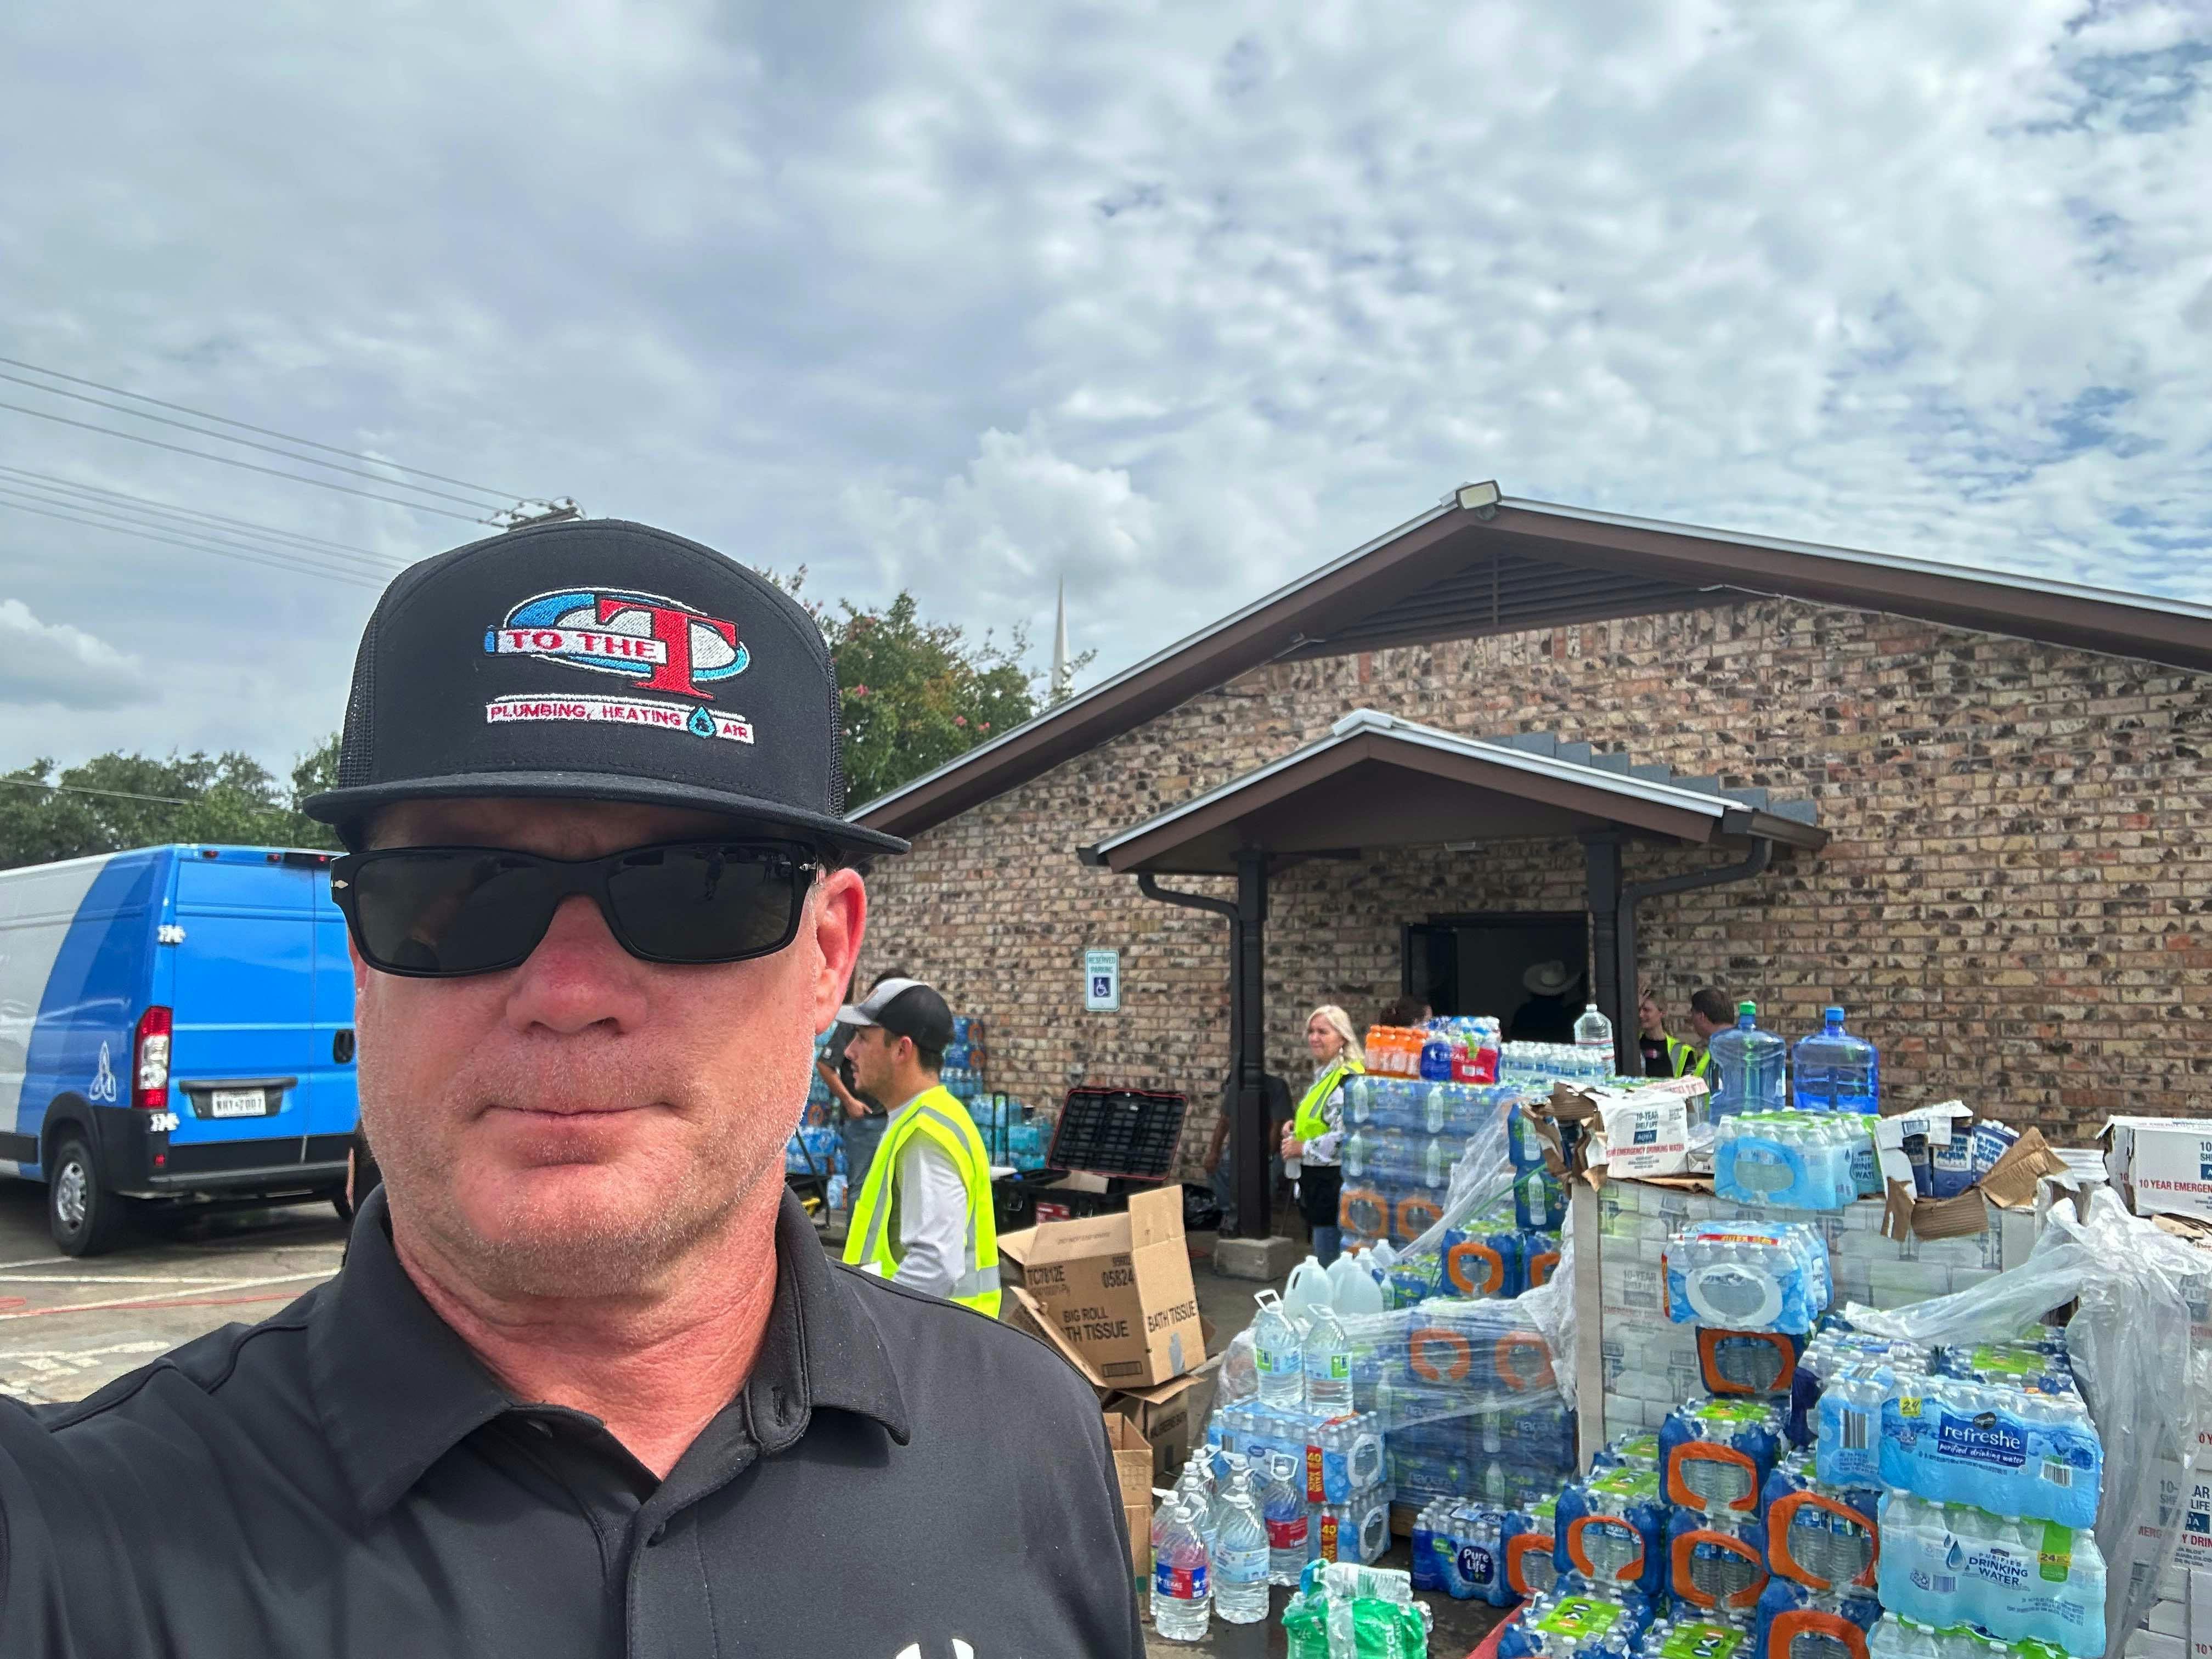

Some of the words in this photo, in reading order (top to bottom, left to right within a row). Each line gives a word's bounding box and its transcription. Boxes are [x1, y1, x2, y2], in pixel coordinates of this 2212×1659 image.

[506, 630, 563, 650] TO
[576, 633, 657, 658] THE
[490, 703, 592, 720] PLUMBING,
[603, 706, 682, 727] HEATING
[723, 723, 748, 739] AIR
[1637, 1110, 1659, 1121] 10-YEAR
[2140, 1180, 2149, 1188] 10
[2151, 1180, 2172, 1190] YEAR
[2174, 1182, 2212, 1194] EMERGEN
[1063, 1309, 1081, 1323] BIG
[1082, 1306, 1109, 1321] ROLL
[1170, 1300, 1197, 1325] TISSUE
[1063, 1324, 1083, 1342] TH
[1084, 1320, 1130, 1340] TISSUE
[1939, 1443, 1967, 1455] purified
[1970, 1448, 2001, 1462] drinking
[2002, 1456, 2023, 1464] water
[1463, 1548, 1489, 1564] Pure
[1979, 1552, 2022, 1567] PURIFIED
[2040, 1553, 2055, 1561] 24
[1466, 1559, 1487, 1573] Life
[1969, 1556, 2028, 1578] DRINKING
[1979, 1567, 2020, 1587] WATER
